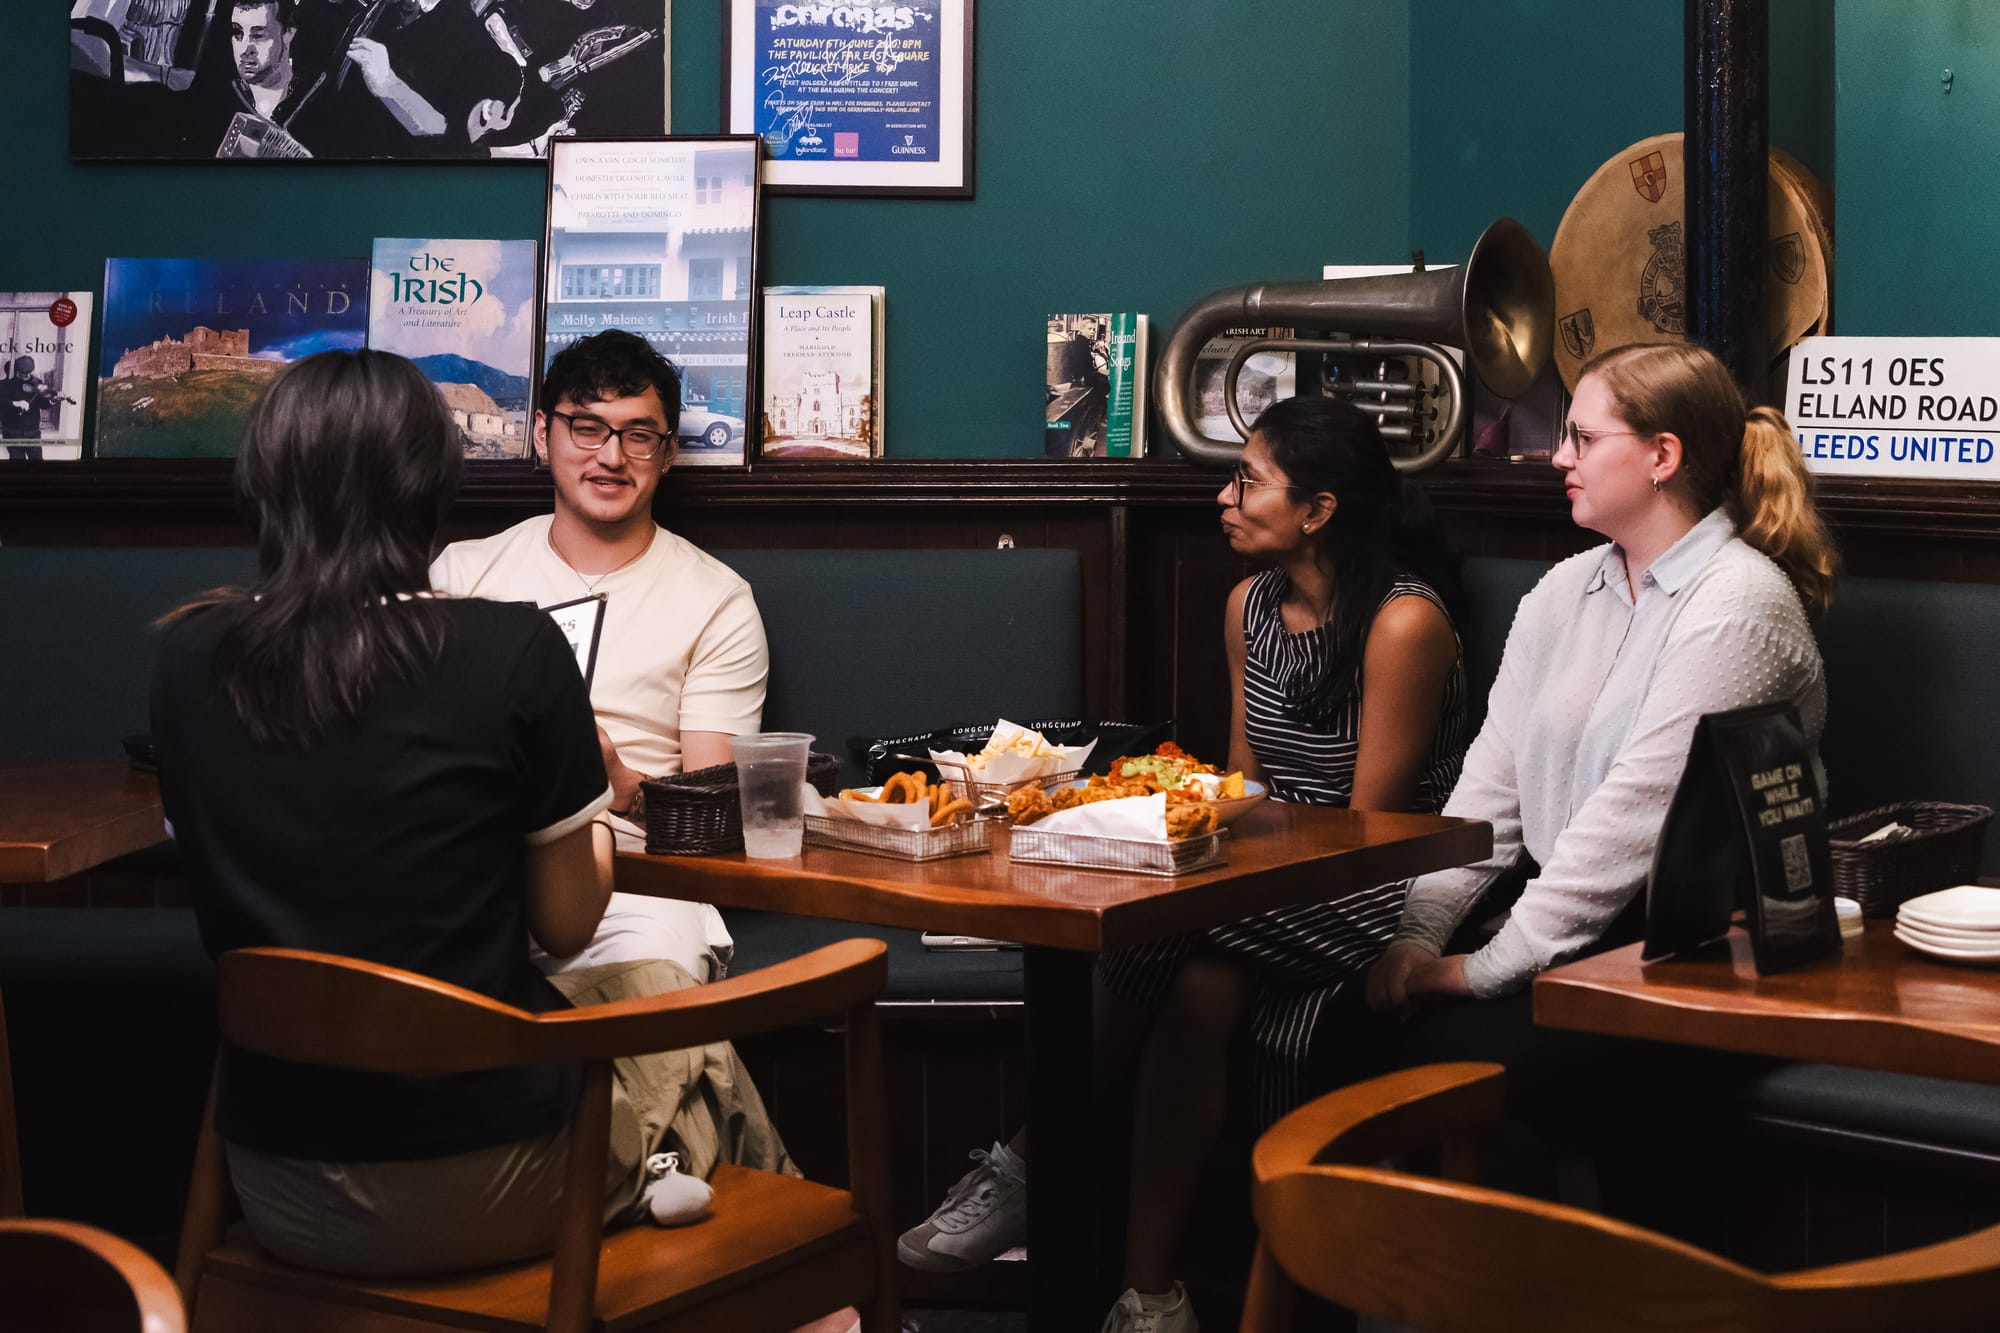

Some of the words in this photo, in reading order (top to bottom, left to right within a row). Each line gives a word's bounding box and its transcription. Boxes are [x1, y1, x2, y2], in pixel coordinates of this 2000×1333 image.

[773, 39, 826, 48] SATURDAY
[849, 39, 874, 48] JUNE
[902, 40, 922, 49] 8PM
[768, 50, 788, 60] THE
[841, 51, 861, 61] FAR
[892, 145, 927, 154] GUINNESS
[407, 307, 442, 316] Treasury
[444, 307, 452, 316] of
[705, 312, 736, 324] Irish
[780, 306, 811, 321] Leap
[816, 306, 856, 319] Castle
[403, 319, 419, 327] and
[422, 319, 461, 327] Literature
[561, 313, 596, 327] Molly
[600, 313, 654, 326] Malone's
[831, 325, 852, 333] People
[25, 337, 74, 353] shore
[1110, 353, 1132, 371] Songs
[1801, 357, 1873, 386] LS11
[1798, 393, 1907, 420] ELLAND
[1917, 395, 1998, 422] ROAD
[1798, 434, 1880, 460] LEEDS
[1890, 436, 1994, 464] UNITED
[952, 725, 996, 735] LONGCHA
[1030, 720, 1082, 729] LONGCHAMP
[883, 733, 933, 746] ONGCHAMP
[1751, 768, 1784, 790] GAME
[1785, 763, 1802, 781] ON
[1758, 807, 1783, 827] YOU
